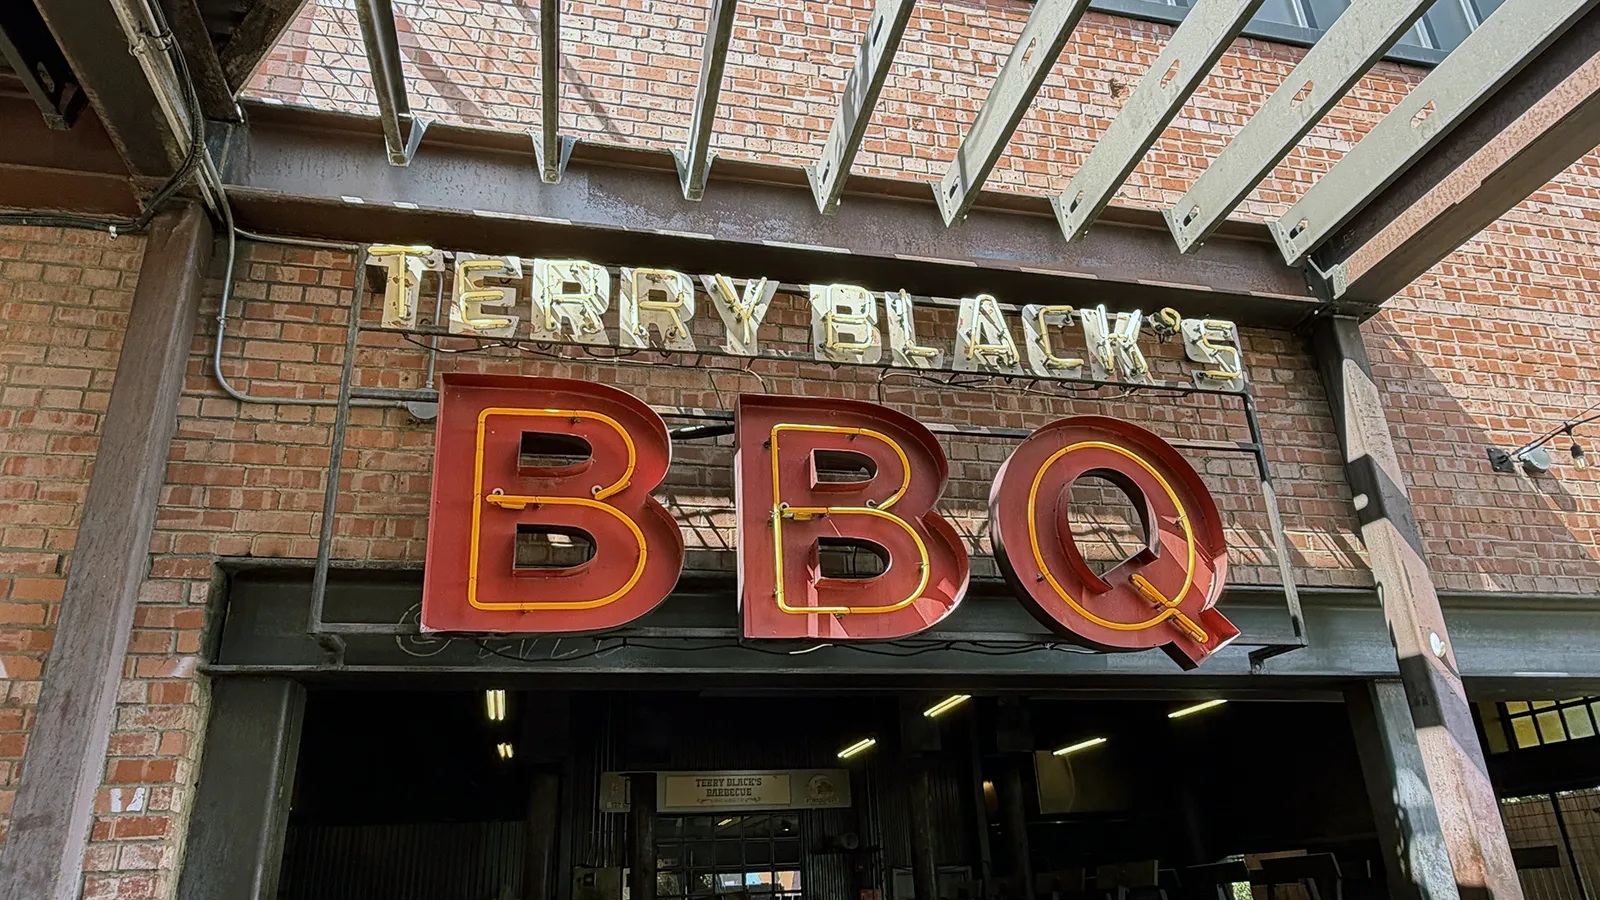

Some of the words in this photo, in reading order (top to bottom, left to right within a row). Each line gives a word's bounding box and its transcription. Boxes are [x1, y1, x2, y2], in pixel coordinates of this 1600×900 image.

[366, 244, 780, 356] TERRY
[809, 283, 1246, 393] BLACK'S
[420, 373, 1241, 671] BBQ
[695, 778, 725, 787] TERRY
[727, 777, 762, 787] BLACK'S
[706, 788, 752, 797] BARBECUE
